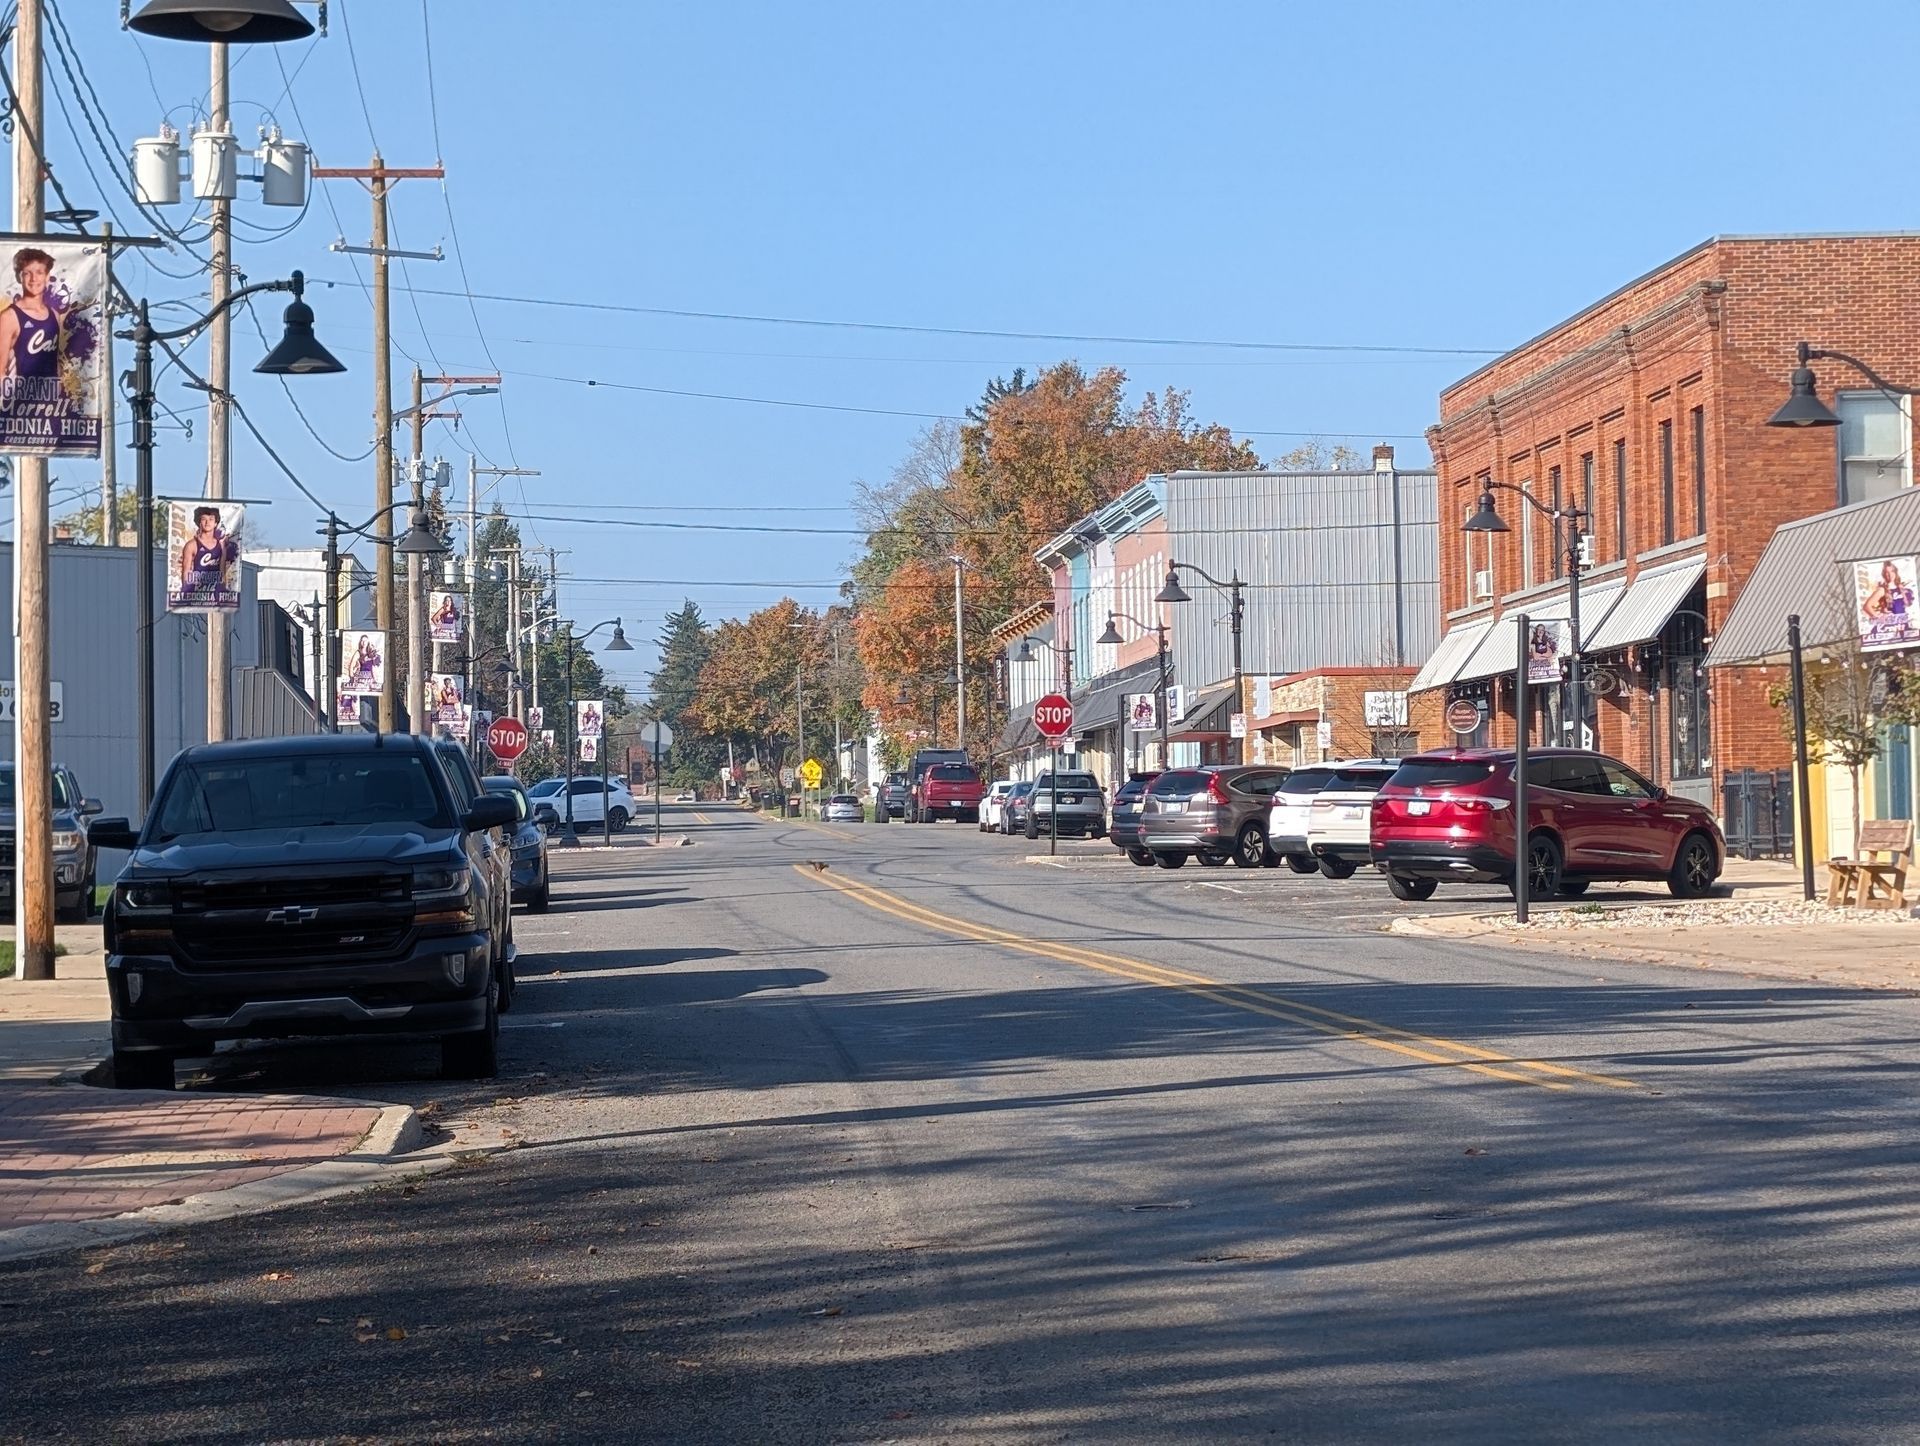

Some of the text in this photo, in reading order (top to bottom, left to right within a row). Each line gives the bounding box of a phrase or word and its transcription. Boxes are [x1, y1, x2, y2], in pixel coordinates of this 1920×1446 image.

[2, 376, 63, 401] GRANT
[60, 418, 98, 437] HIGH
[170, 591, 216, 602] CALEDONIA
[1036, 706, 1072, 724] STOP
[490, 728, 526, 748] STOP
